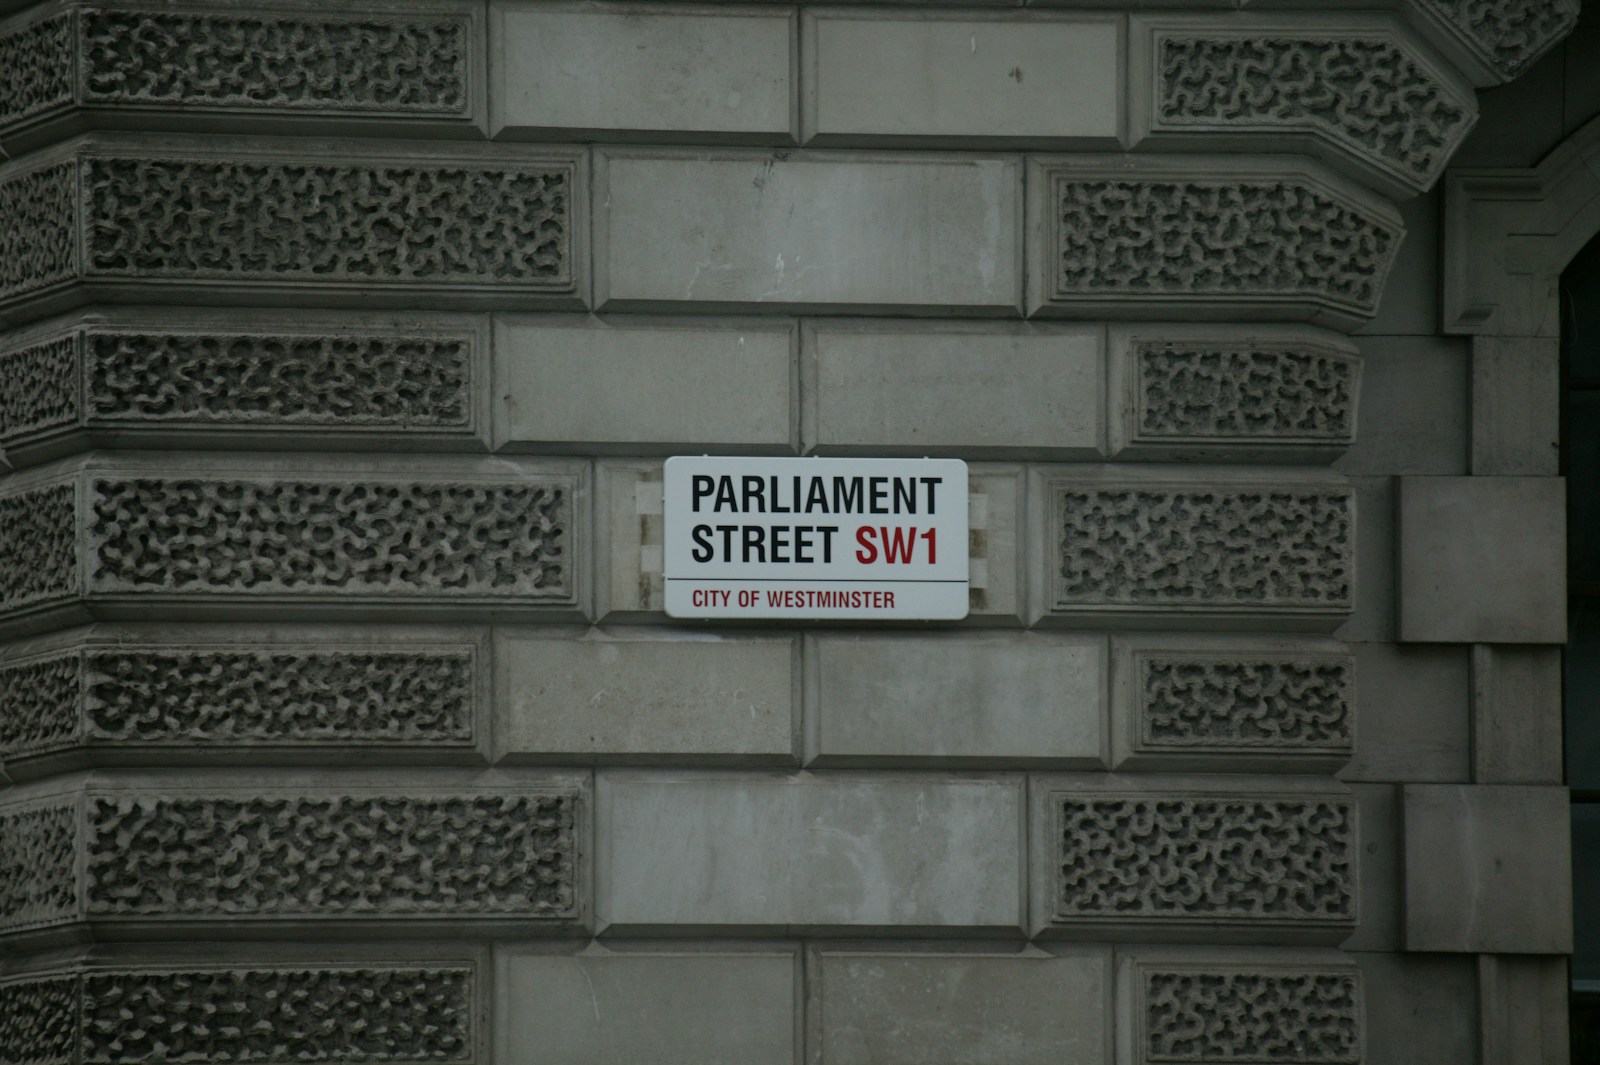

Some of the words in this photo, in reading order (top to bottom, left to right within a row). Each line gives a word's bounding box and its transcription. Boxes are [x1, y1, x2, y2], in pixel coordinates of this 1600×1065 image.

[692, 475, 942, 514] PARLIAMENT
[692, 524, 839, 563] STREET
[856, 526, 937, 564] SW1
[692, 590, 731, 607] CITY
[738, 590, 760, 607] OF
[767, 591, 895, 608] WESTMINSTER
